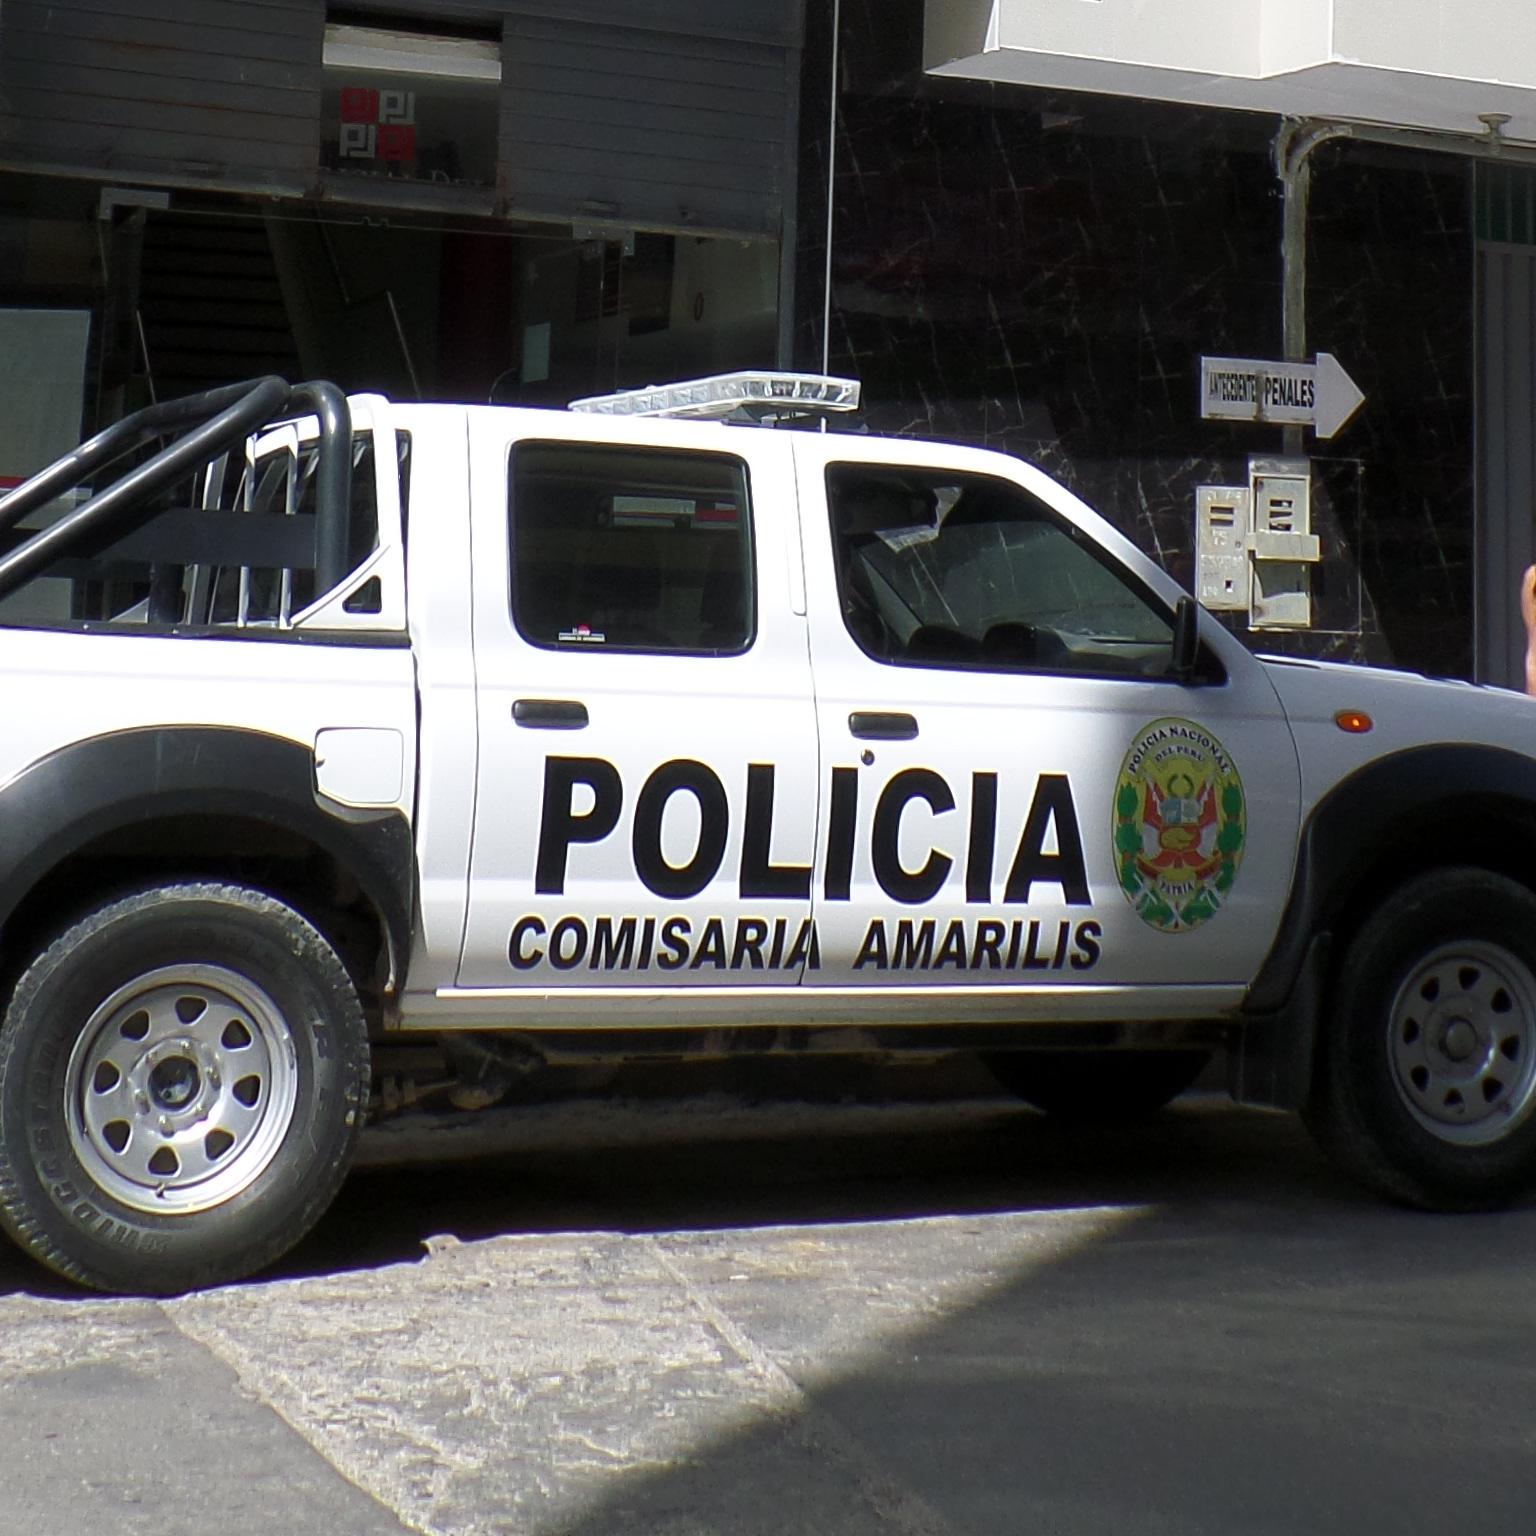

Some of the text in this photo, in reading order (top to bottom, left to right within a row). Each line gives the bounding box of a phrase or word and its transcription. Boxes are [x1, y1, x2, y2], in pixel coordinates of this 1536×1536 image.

[1209, 372, 1314, 408] ANTECEDENTE PENALES
[1128, 727, 1230, 773] POLICIA NACIONAL
[1155, 746, 1174, 763] DEL
[534, 756, 1092, 906] POLICIA
[508, 916, 1102, 971] COMISARIA AMARILIS
